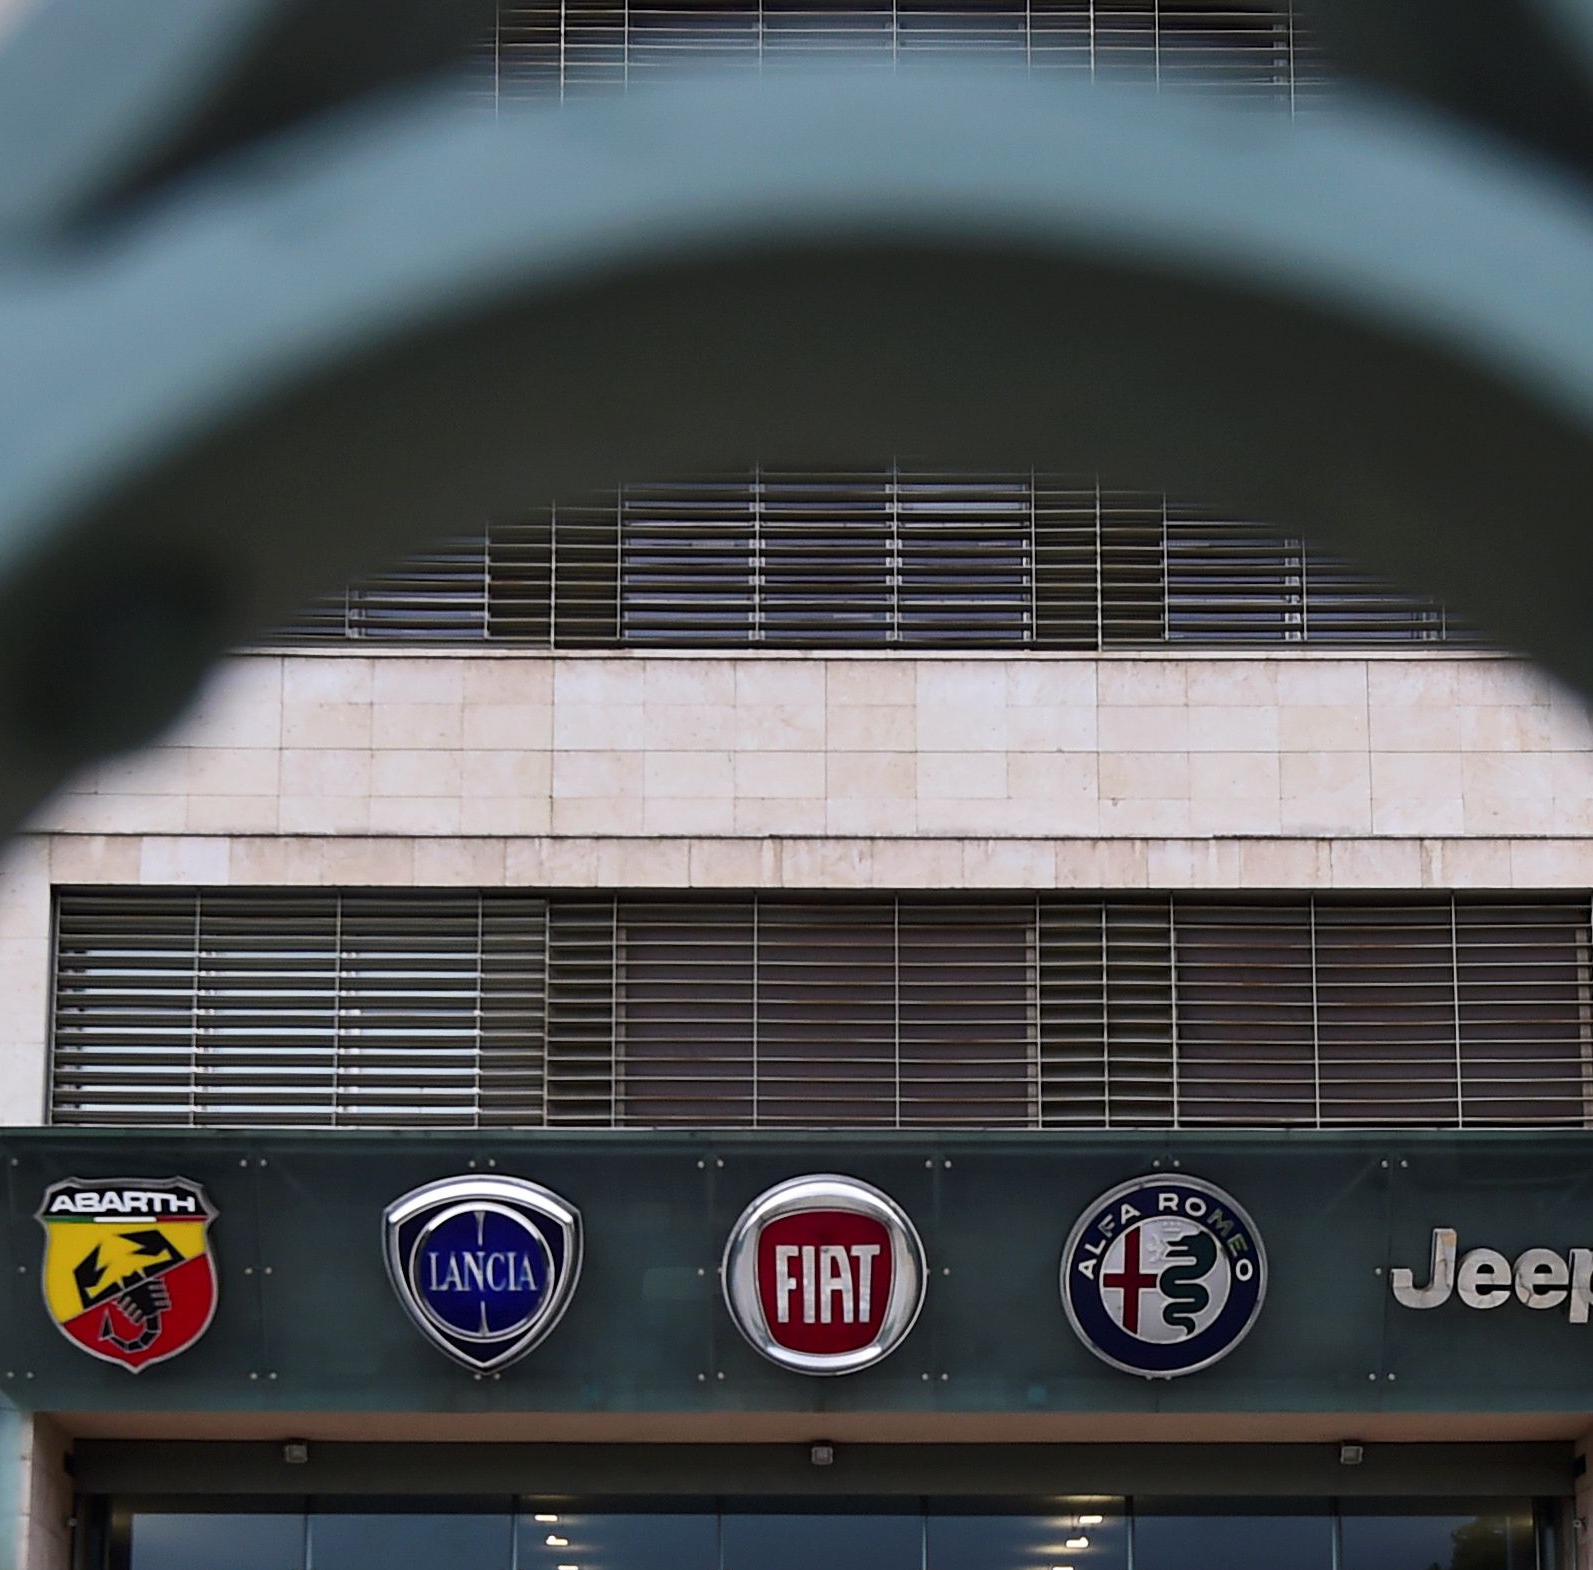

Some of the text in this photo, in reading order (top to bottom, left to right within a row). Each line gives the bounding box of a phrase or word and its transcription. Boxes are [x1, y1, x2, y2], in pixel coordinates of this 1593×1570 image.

[49, 1190, 196, 1213] ABARTH
[1078, 1192, 1254, 1281] ALFA ROMEO
[428, 1251, 538, 1292] LANCIA
[775, 1244, 881, 1324] FIAT
